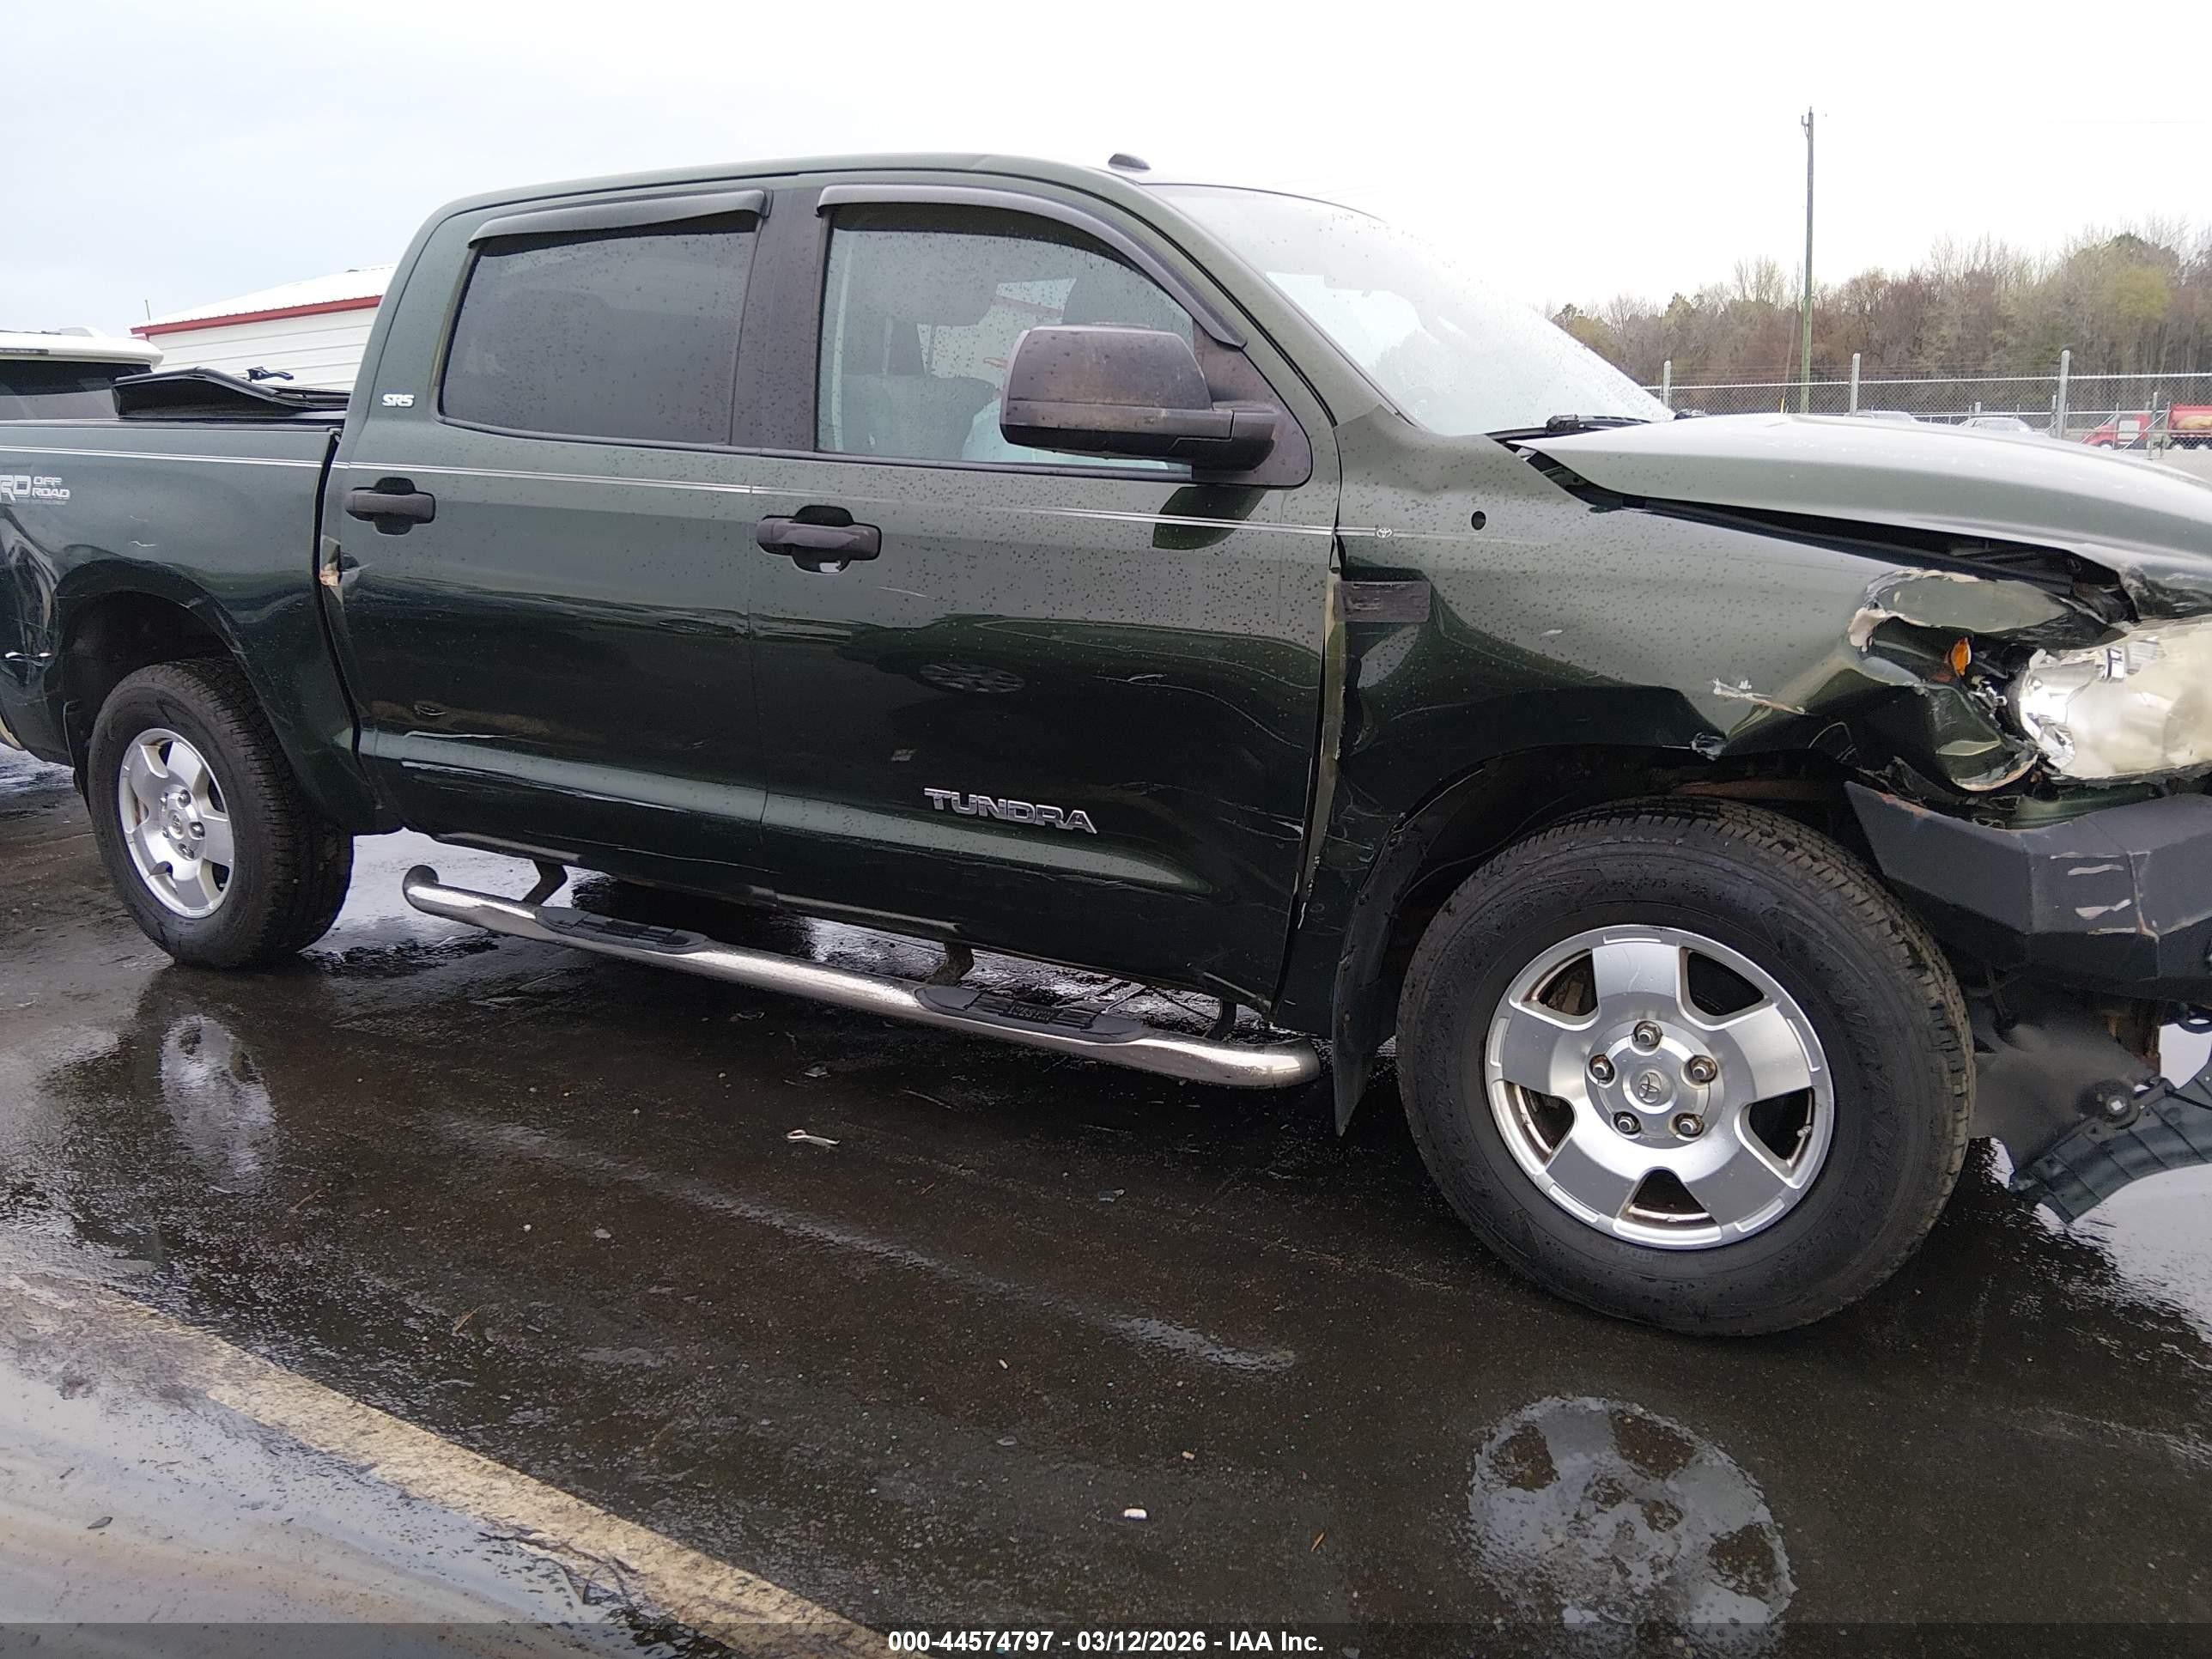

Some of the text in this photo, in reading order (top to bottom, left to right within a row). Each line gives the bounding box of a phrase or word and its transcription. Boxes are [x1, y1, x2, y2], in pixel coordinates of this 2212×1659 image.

[33, 476, 63, 487] OFF
[31, 487, 70, 501] ROAD
[924, 787, 1098, 835] TUNDRA
